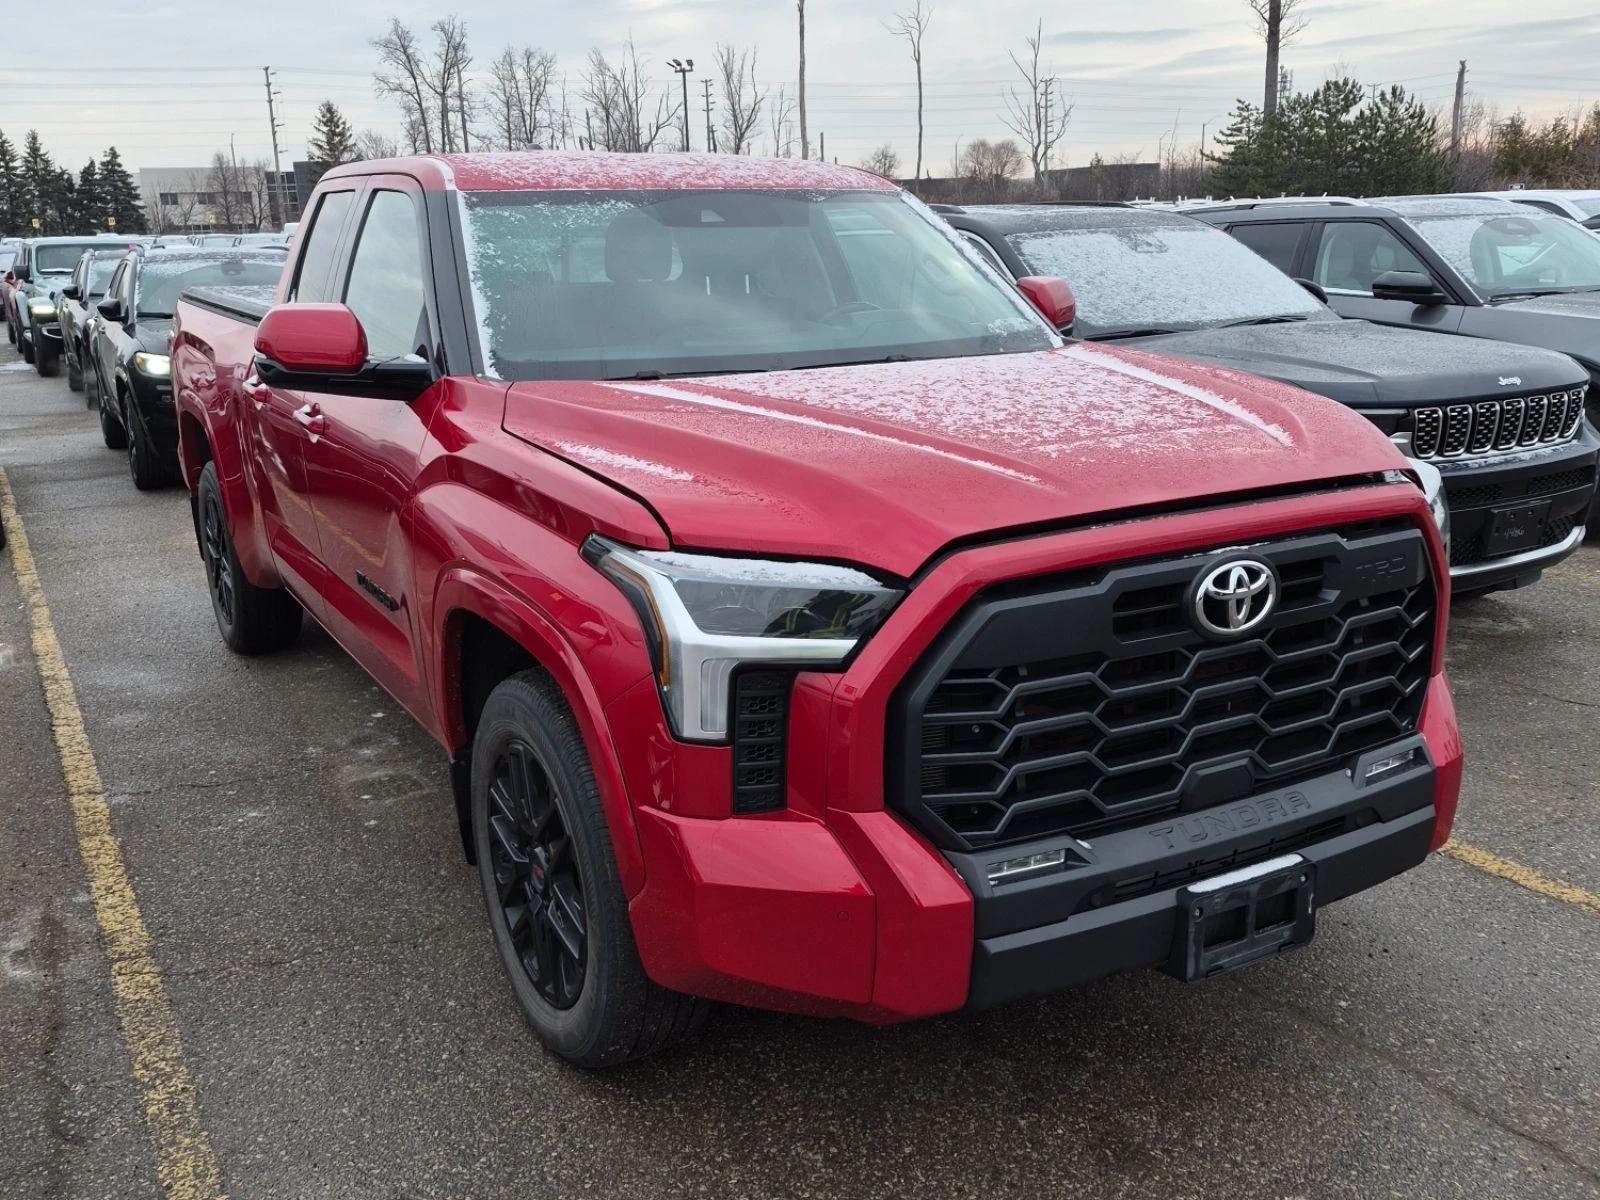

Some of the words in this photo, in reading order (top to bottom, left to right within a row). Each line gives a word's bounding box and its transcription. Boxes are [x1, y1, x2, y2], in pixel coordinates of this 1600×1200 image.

[1498, 376, 1522, 386] Jeep
[1355, 554, 1406, 582] TRD
[1149, 790, 1311, 850] TUNDRA
